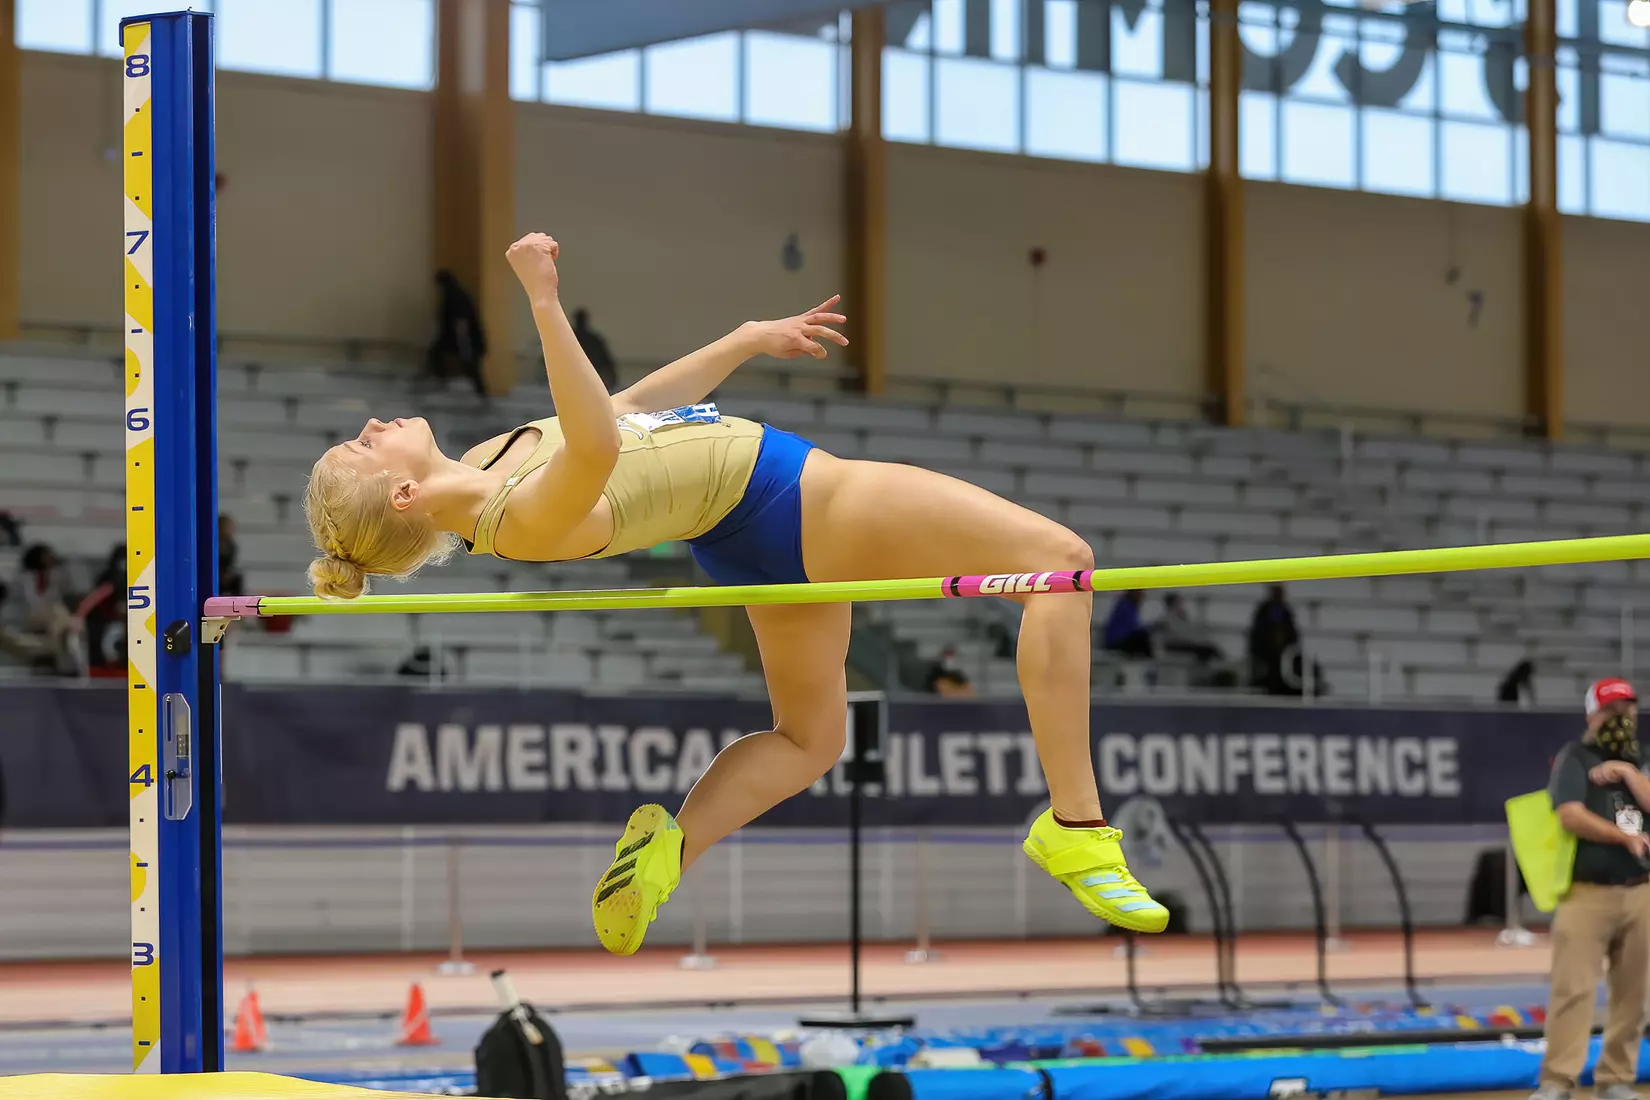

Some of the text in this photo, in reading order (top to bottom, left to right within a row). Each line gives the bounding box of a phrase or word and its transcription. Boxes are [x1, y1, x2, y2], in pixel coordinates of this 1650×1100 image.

[125, 54, 150, 78] 8
[126, 230, 150, 255] 7
[126, 407, 150, 432] 6
[979, 571, 1055, 595] GILL
[128, 585, 151, 610] 5
[386, 723, 745, 793] AMERICA
[1099, 733, 1461, 796] CONFERENCE
[129, 763, 154, 788] 4
[132, 942, 154, 966] 3
